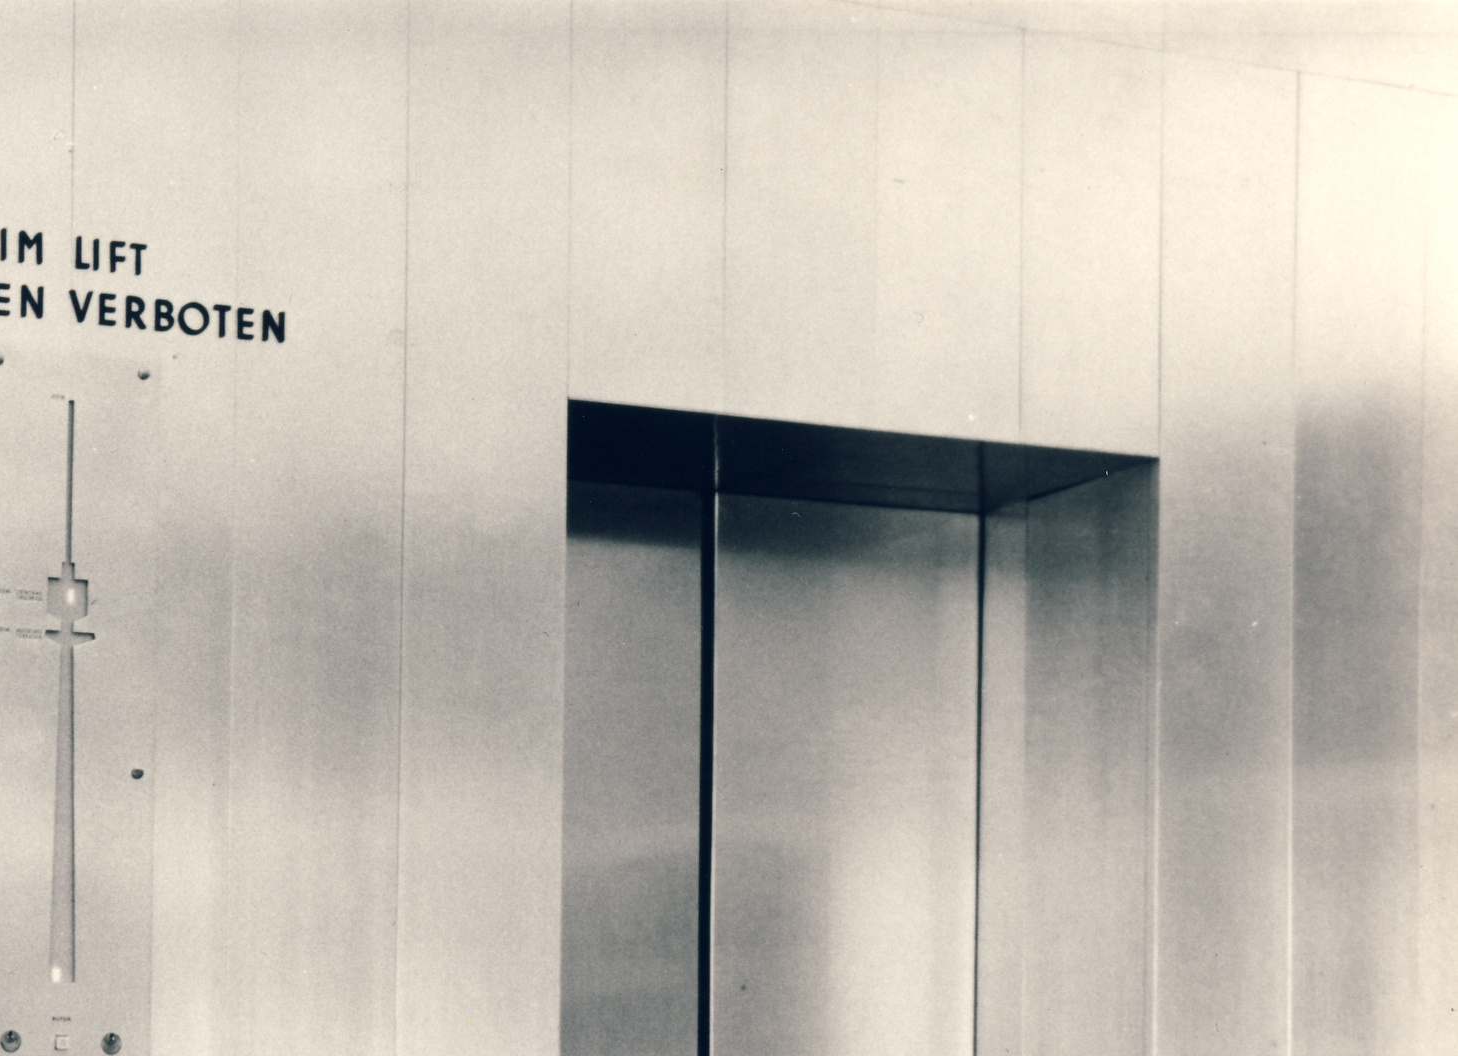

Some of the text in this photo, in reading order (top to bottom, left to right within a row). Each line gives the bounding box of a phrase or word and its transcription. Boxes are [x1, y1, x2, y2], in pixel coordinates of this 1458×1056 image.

[0, 228, 148, 276] IM LIFT
[69, 289, 286, 344] VERBOTEN
